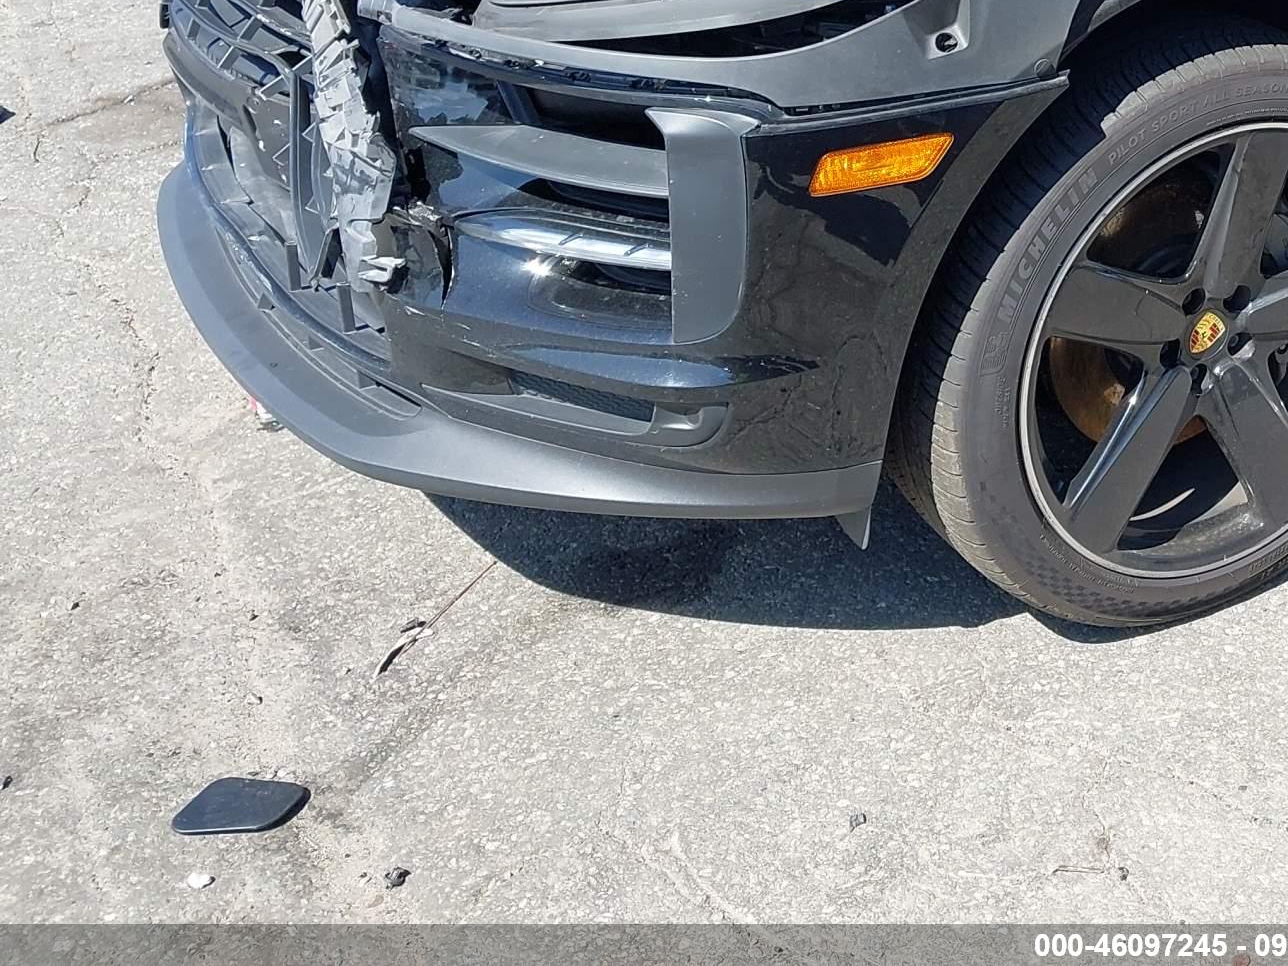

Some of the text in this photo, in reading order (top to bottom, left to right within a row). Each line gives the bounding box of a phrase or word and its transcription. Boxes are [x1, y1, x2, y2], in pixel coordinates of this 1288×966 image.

[997, 168, 1099, 324] MICHELIN
[1108, 127, 1147, 165] PILOT
[1151, 102, 1198, 132] SPORT
